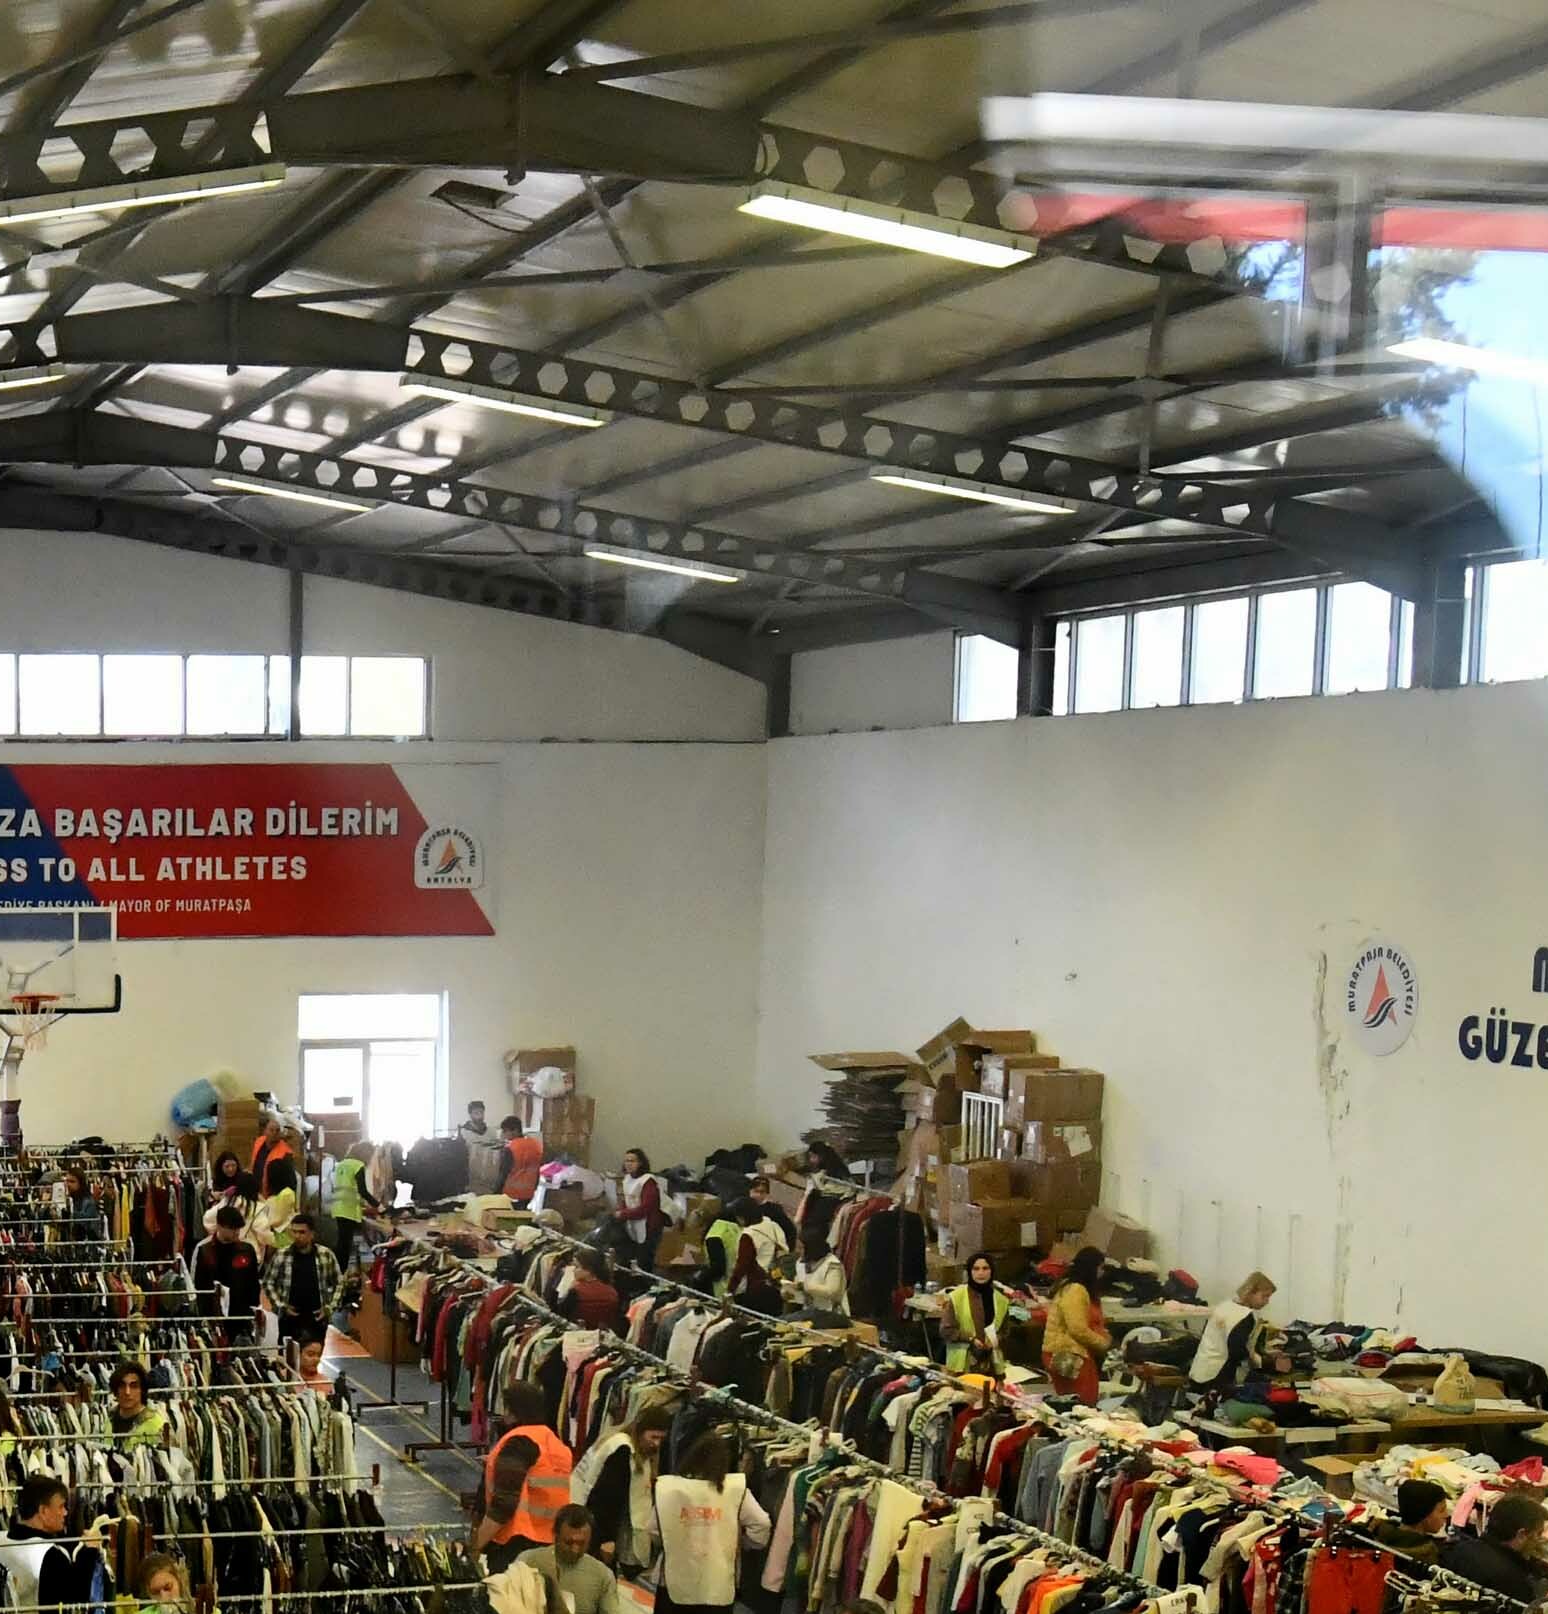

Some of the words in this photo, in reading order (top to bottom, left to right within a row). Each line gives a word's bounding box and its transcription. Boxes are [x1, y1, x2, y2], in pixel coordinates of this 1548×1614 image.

[54, 807, 254, 844] BAŞARILAR
[266, 800, 398, 836] DİLERİM
[38, 857, 76, 882] TO
[87, 856, 145, 882] ALL
[156, 855, 308, 881] ATHLETES
[155, 898, 172, 913] OF
[175, 897, 253, 914] MURATPAŞA
